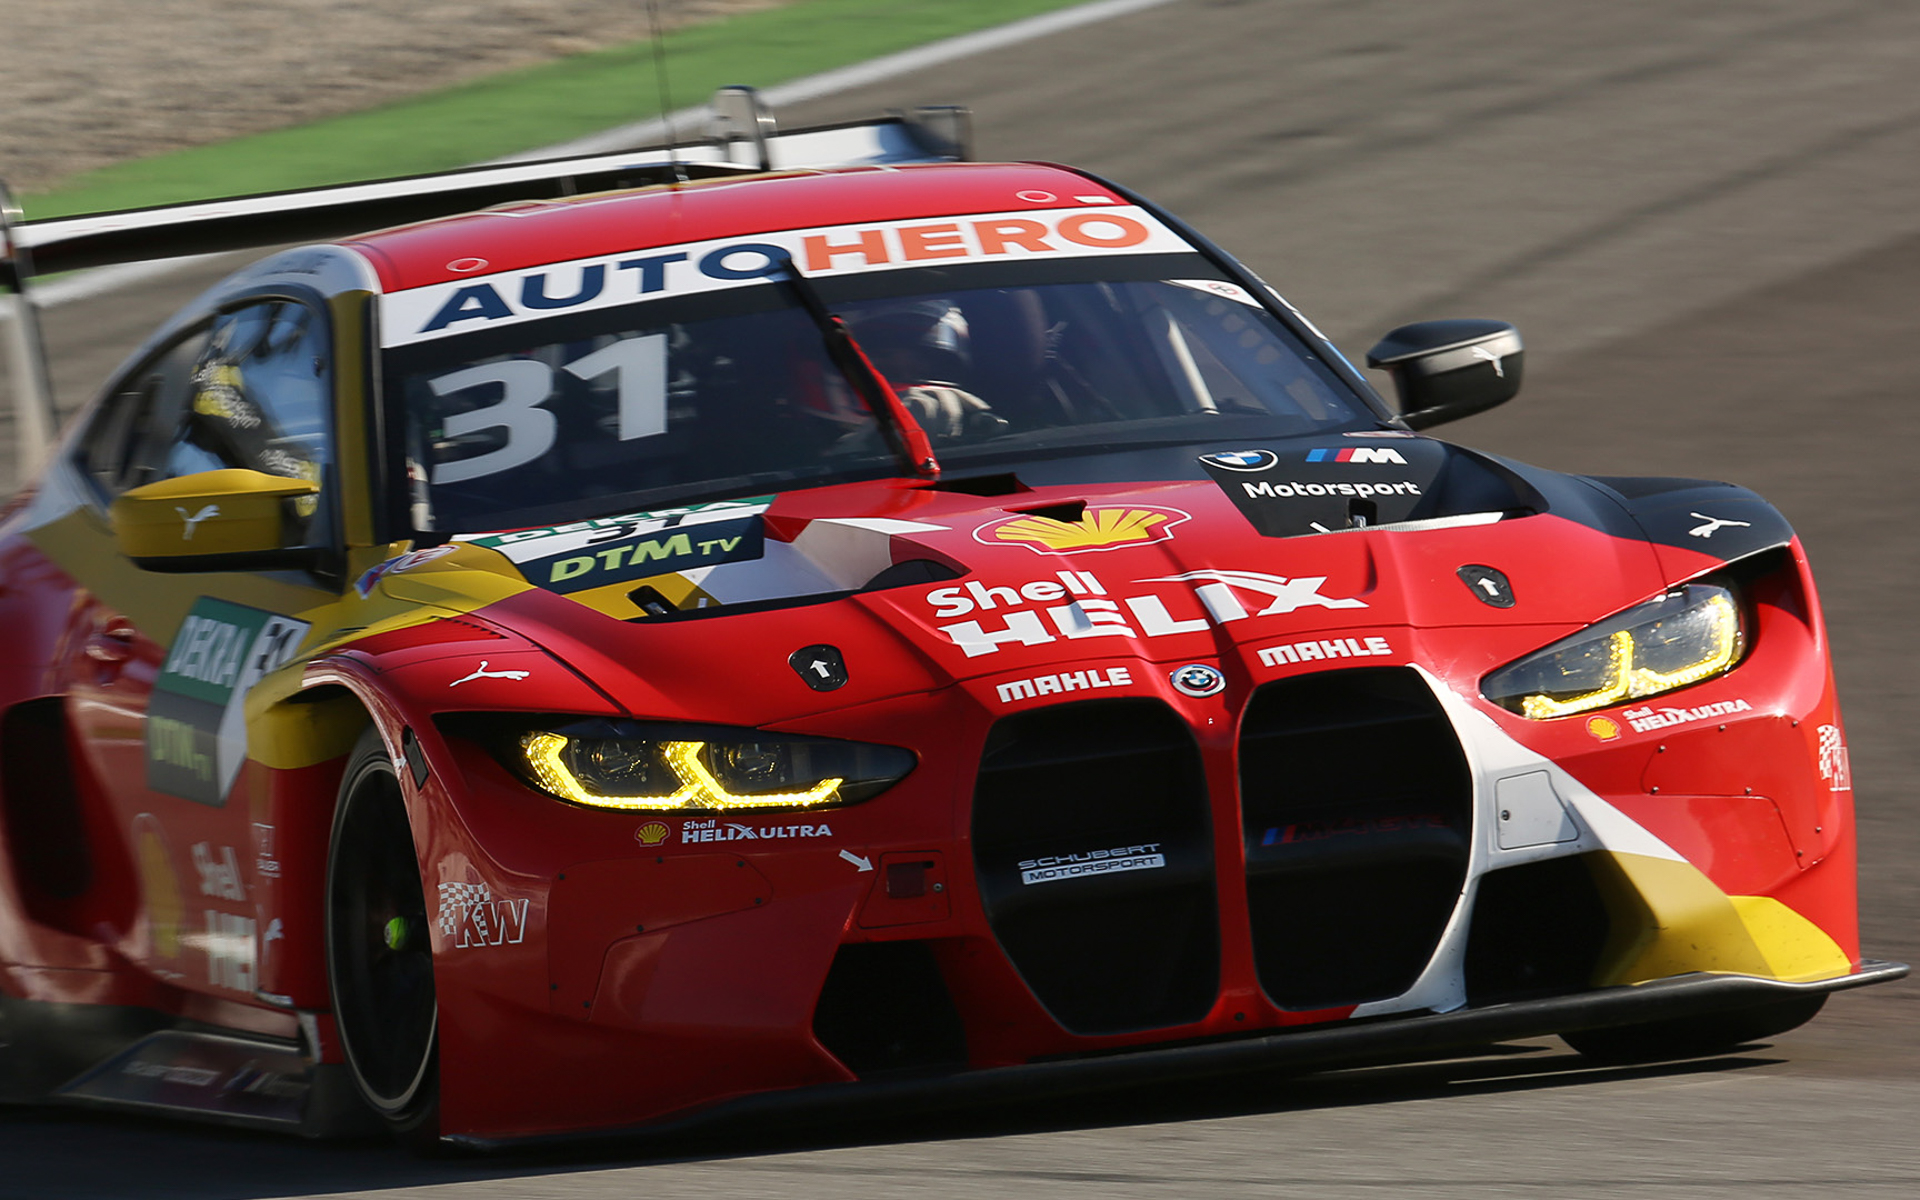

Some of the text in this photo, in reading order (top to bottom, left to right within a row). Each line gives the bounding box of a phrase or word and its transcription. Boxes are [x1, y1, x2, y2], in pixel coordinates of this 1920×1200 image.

[415, 213, 1149, 334] AUTOHERO
[428, 333, 668, 485] 31
[1242, 481, 1422, 499] Motorsport
[550, 533, 742, 583] DTM TV
[927, 571, 1108, 618] Shell
[937, 570, 1370, 659] HELIX
[1256, 637, 1393, 668] MAHLE
[996, 667, 1133, 703] MAHLE
[1622, 706, 1654, 720] Shell
[1628, 699, 1752, 733] HELIX ULTRA
[682, 820, 715, 830] Shell
[682, 823, 832, 843] HELIX ULTRA
[1017, 843, 1161, 870] SCHUBERT
[1029, 857, 1158, 881] MOTORSPORT
[455, 898, 529, 948] KW
